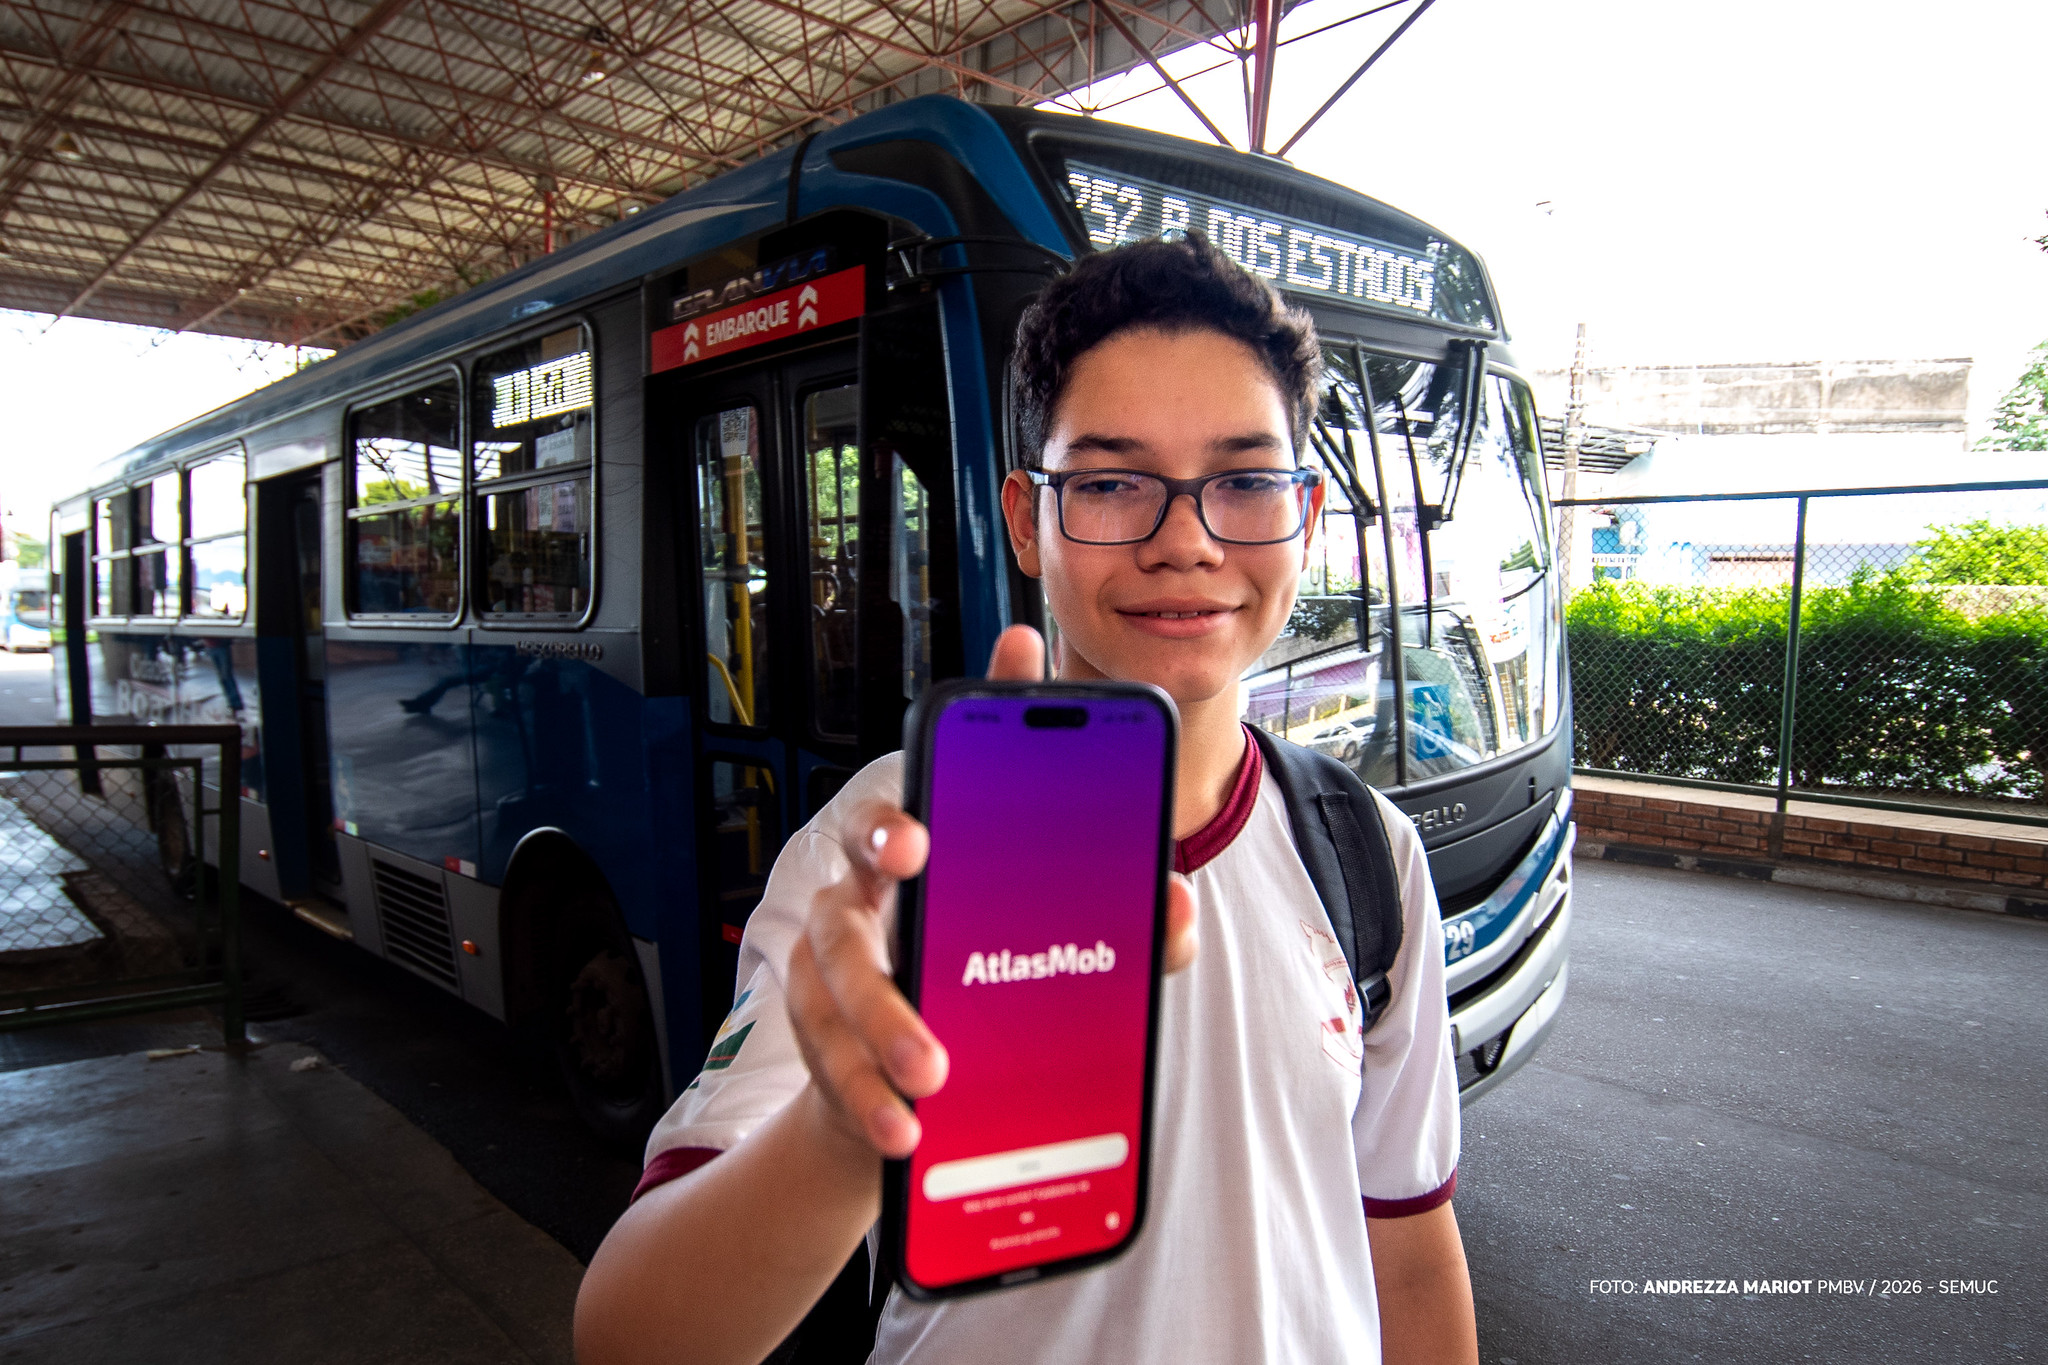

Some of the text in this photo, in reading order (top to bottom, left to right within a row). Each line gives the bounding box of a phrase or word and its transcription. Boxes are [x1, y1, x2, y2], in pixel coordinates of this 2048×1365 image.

[1286, 228, 1435, 312] ESTADOS
[706, 300, 790, 346] EMBARQUE
[961, 940, 1116, 986] AtlasMob
[1446, 920, 1476, 961] 29
